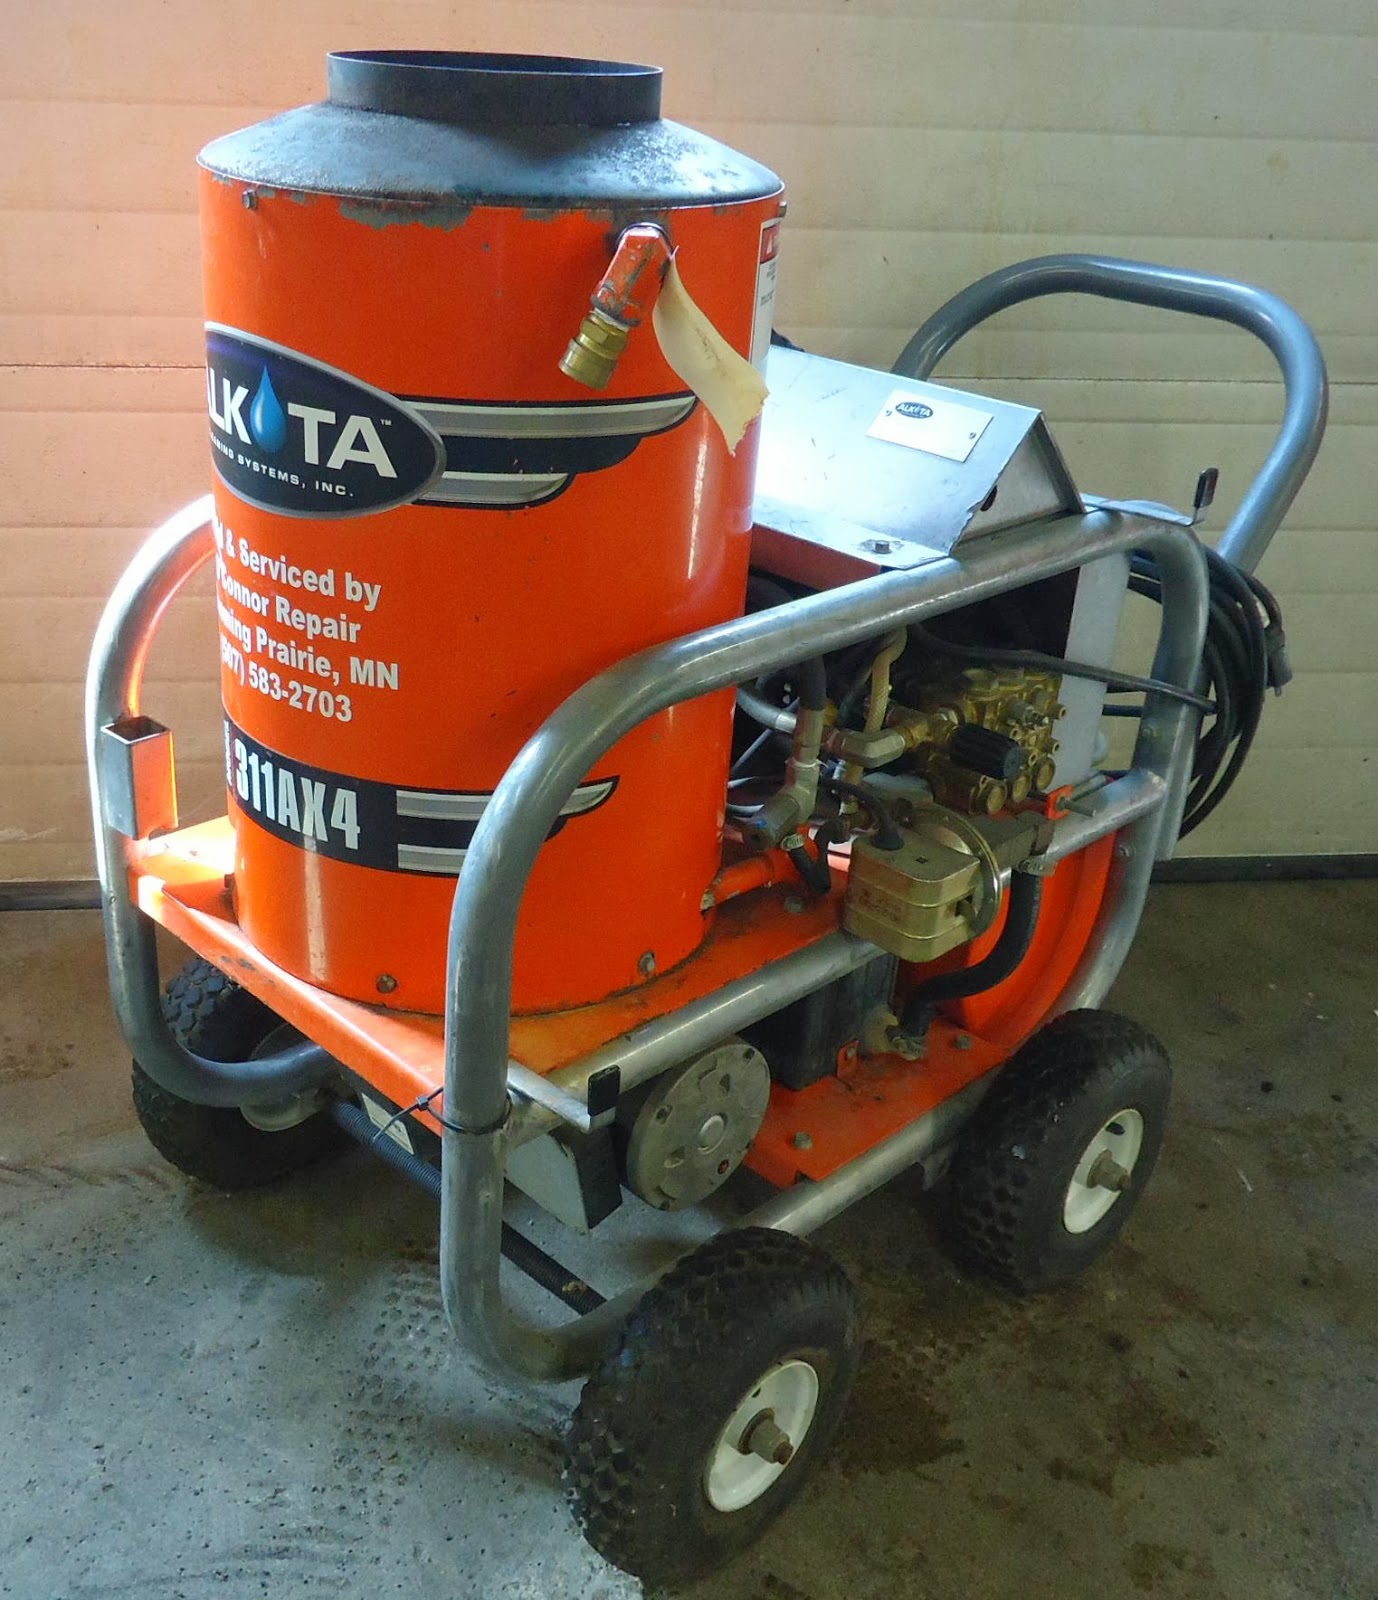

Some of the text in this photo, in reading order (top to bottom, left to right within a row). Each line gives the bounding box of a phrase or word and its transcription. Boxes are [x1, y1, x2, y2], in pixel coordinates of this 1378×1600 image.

[206, 367, 398, 479] LKOTA
[237, 456, 306, 489] SYSTEMS,
[315, 480, 353, 497] INC.
[226, 528, 235, 558] &
[239, 538, 335, 597] Serviced
[345, 572, 382, 612] by
[275, 595, 361, 643] Repair
[256, 625, 340, 686] Prairie,
[349, 656, 399, 690] MN
[248, 662, 352, 723] 583-2703
[234, 738, 361, 850] 311AX4
